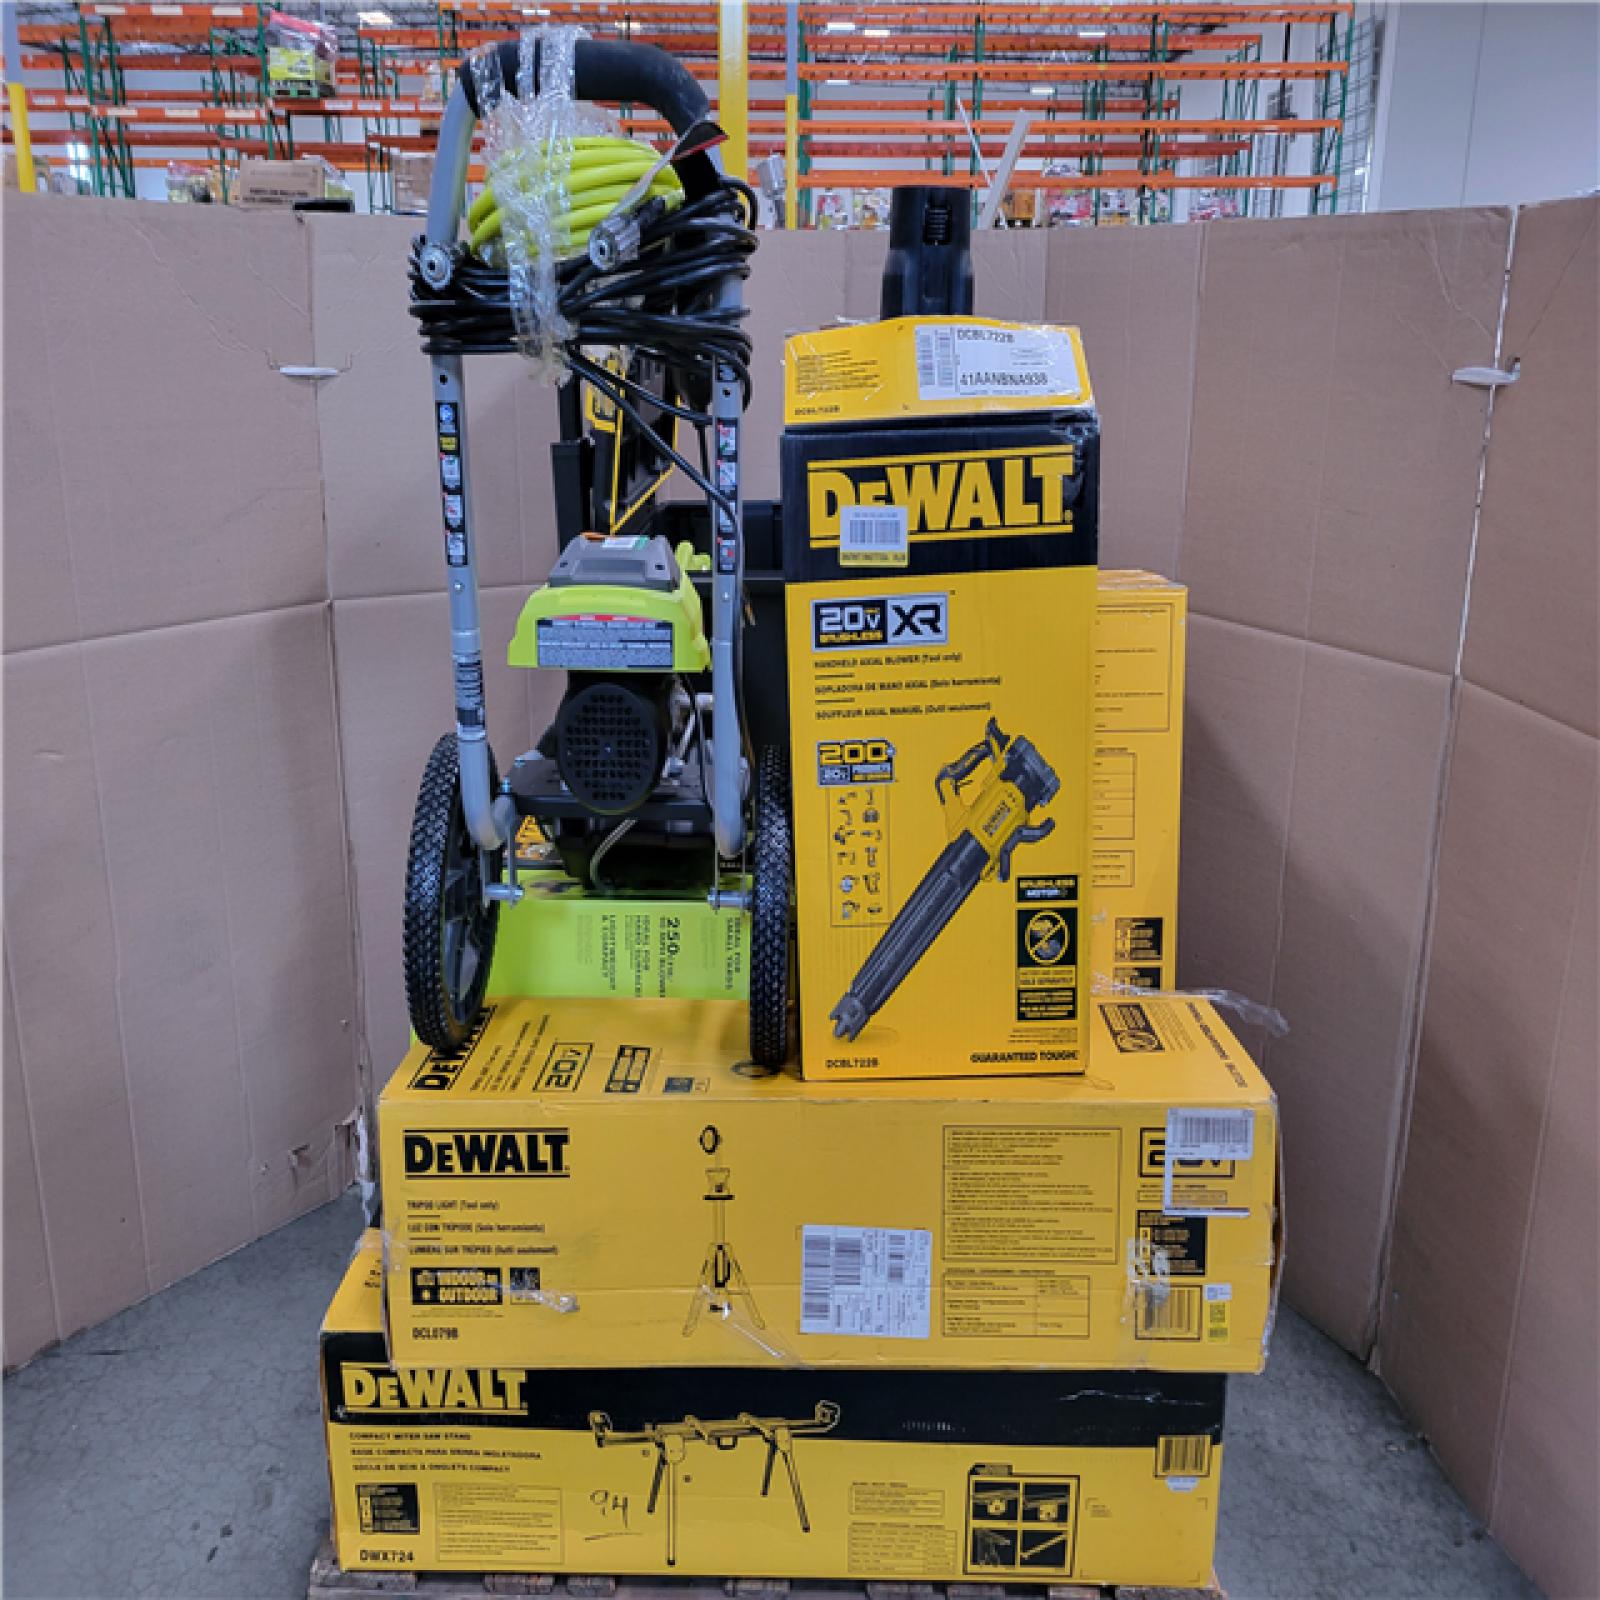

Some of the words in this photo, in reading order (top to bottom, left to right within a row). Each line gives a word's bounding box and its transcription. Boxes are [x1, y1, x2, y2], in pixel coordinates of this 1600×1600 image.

[892, 602, 943, 637] XR
[814, 659, 858, 669] HANDHELD
[860, 657, 883, 666] AXIAL
[885, 654, 920, 665] BLOWER
[814, 684, 864, 695] SOPLADORA
[865, 683, 876, 691] DE
[880, 681, 903, 691] MANO
[904, 680, 928, 689] AXIAL
[815, 709, 863, 720] SOUFFLEUR
[864, 707, 889, 717] AXIAL
[820, 741, 888, 765] 200
[969, 1051, 1038, 1064] GUARANTEED
[407, 1200, 433, 1210] TRIPOD
[436, 1200, 457, 1210] LIGHT
[439, 1287, 498, 1303] OUTDOOR
[349, 1432, 391, 1441] COMPACT
[394, 1432, 421, 1441] MITER
[424, 1432, 441, 1441] SAW
[444, 1432, 471, 1441] STAND
[359, 1550, 415, 1563] DWX724
